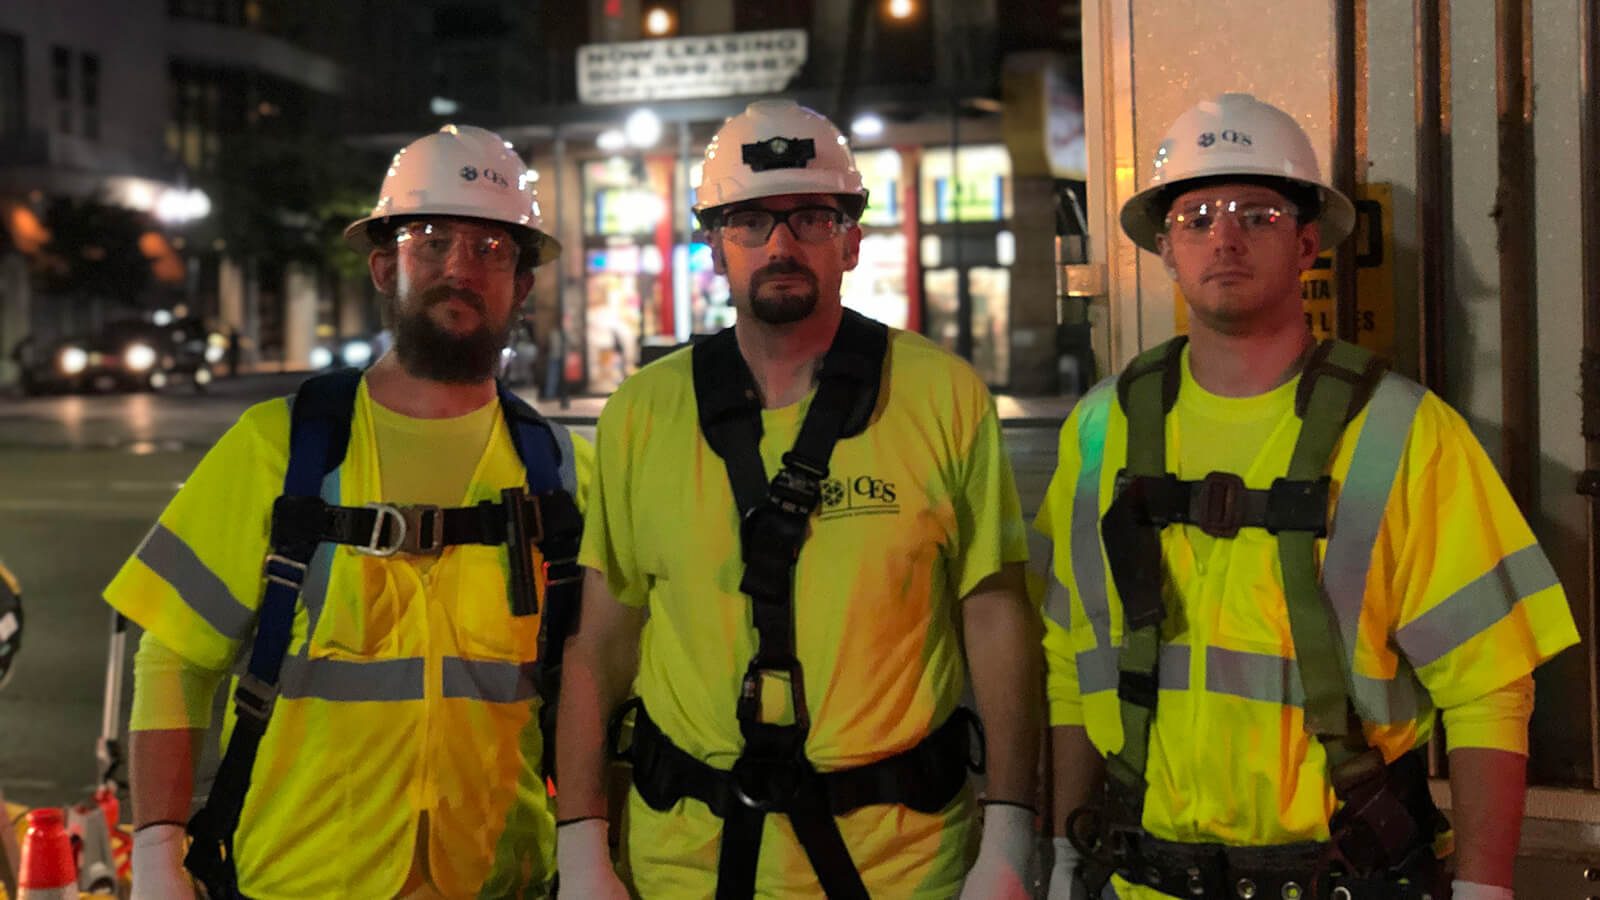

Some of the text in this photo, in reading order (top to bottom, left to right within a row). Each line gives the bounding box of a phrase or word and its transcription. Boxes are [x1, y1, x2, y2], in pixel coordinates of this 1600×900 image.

[587, 37, 798, 65] NOW LEASING
[854, 475, 897, 504] CES
